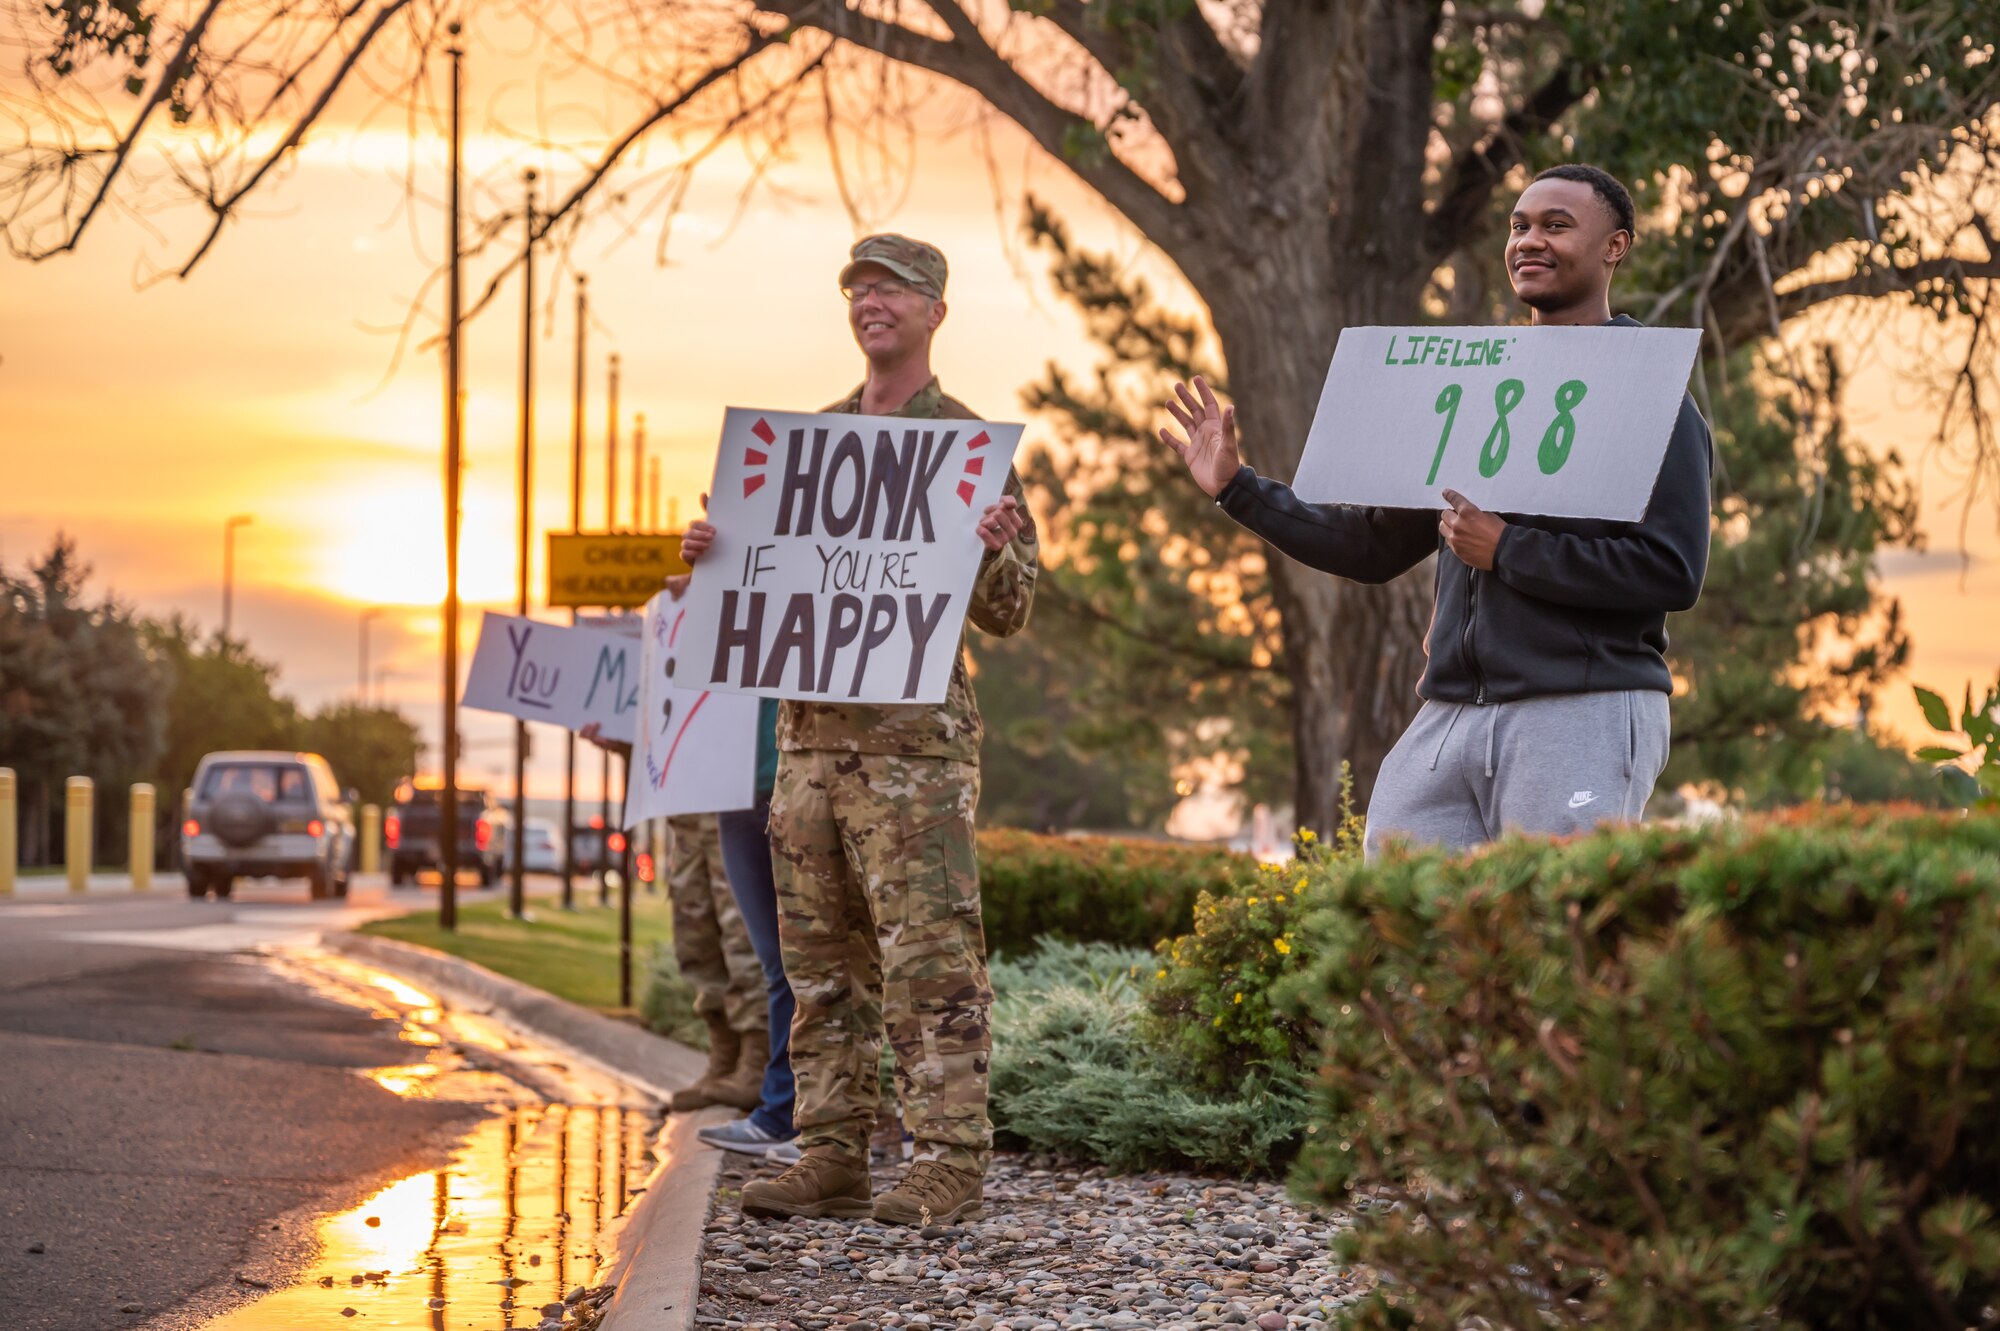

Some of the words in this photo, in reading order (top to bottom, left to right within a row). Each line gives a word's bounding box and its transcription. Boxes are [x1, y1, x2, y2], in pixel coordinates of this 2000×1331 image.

[1385, 336, 1518, 368] LIFELINE:
[773, 428, 959, 543] HONK
[583, 545, 665, 566] CHECK
[741, 544, 777, 587] IF
[816, 544, 919, 593] YOU'RE
[709, 589, 952, 700] HAPPY
[1573, 790, 1593, 802] NIKE
